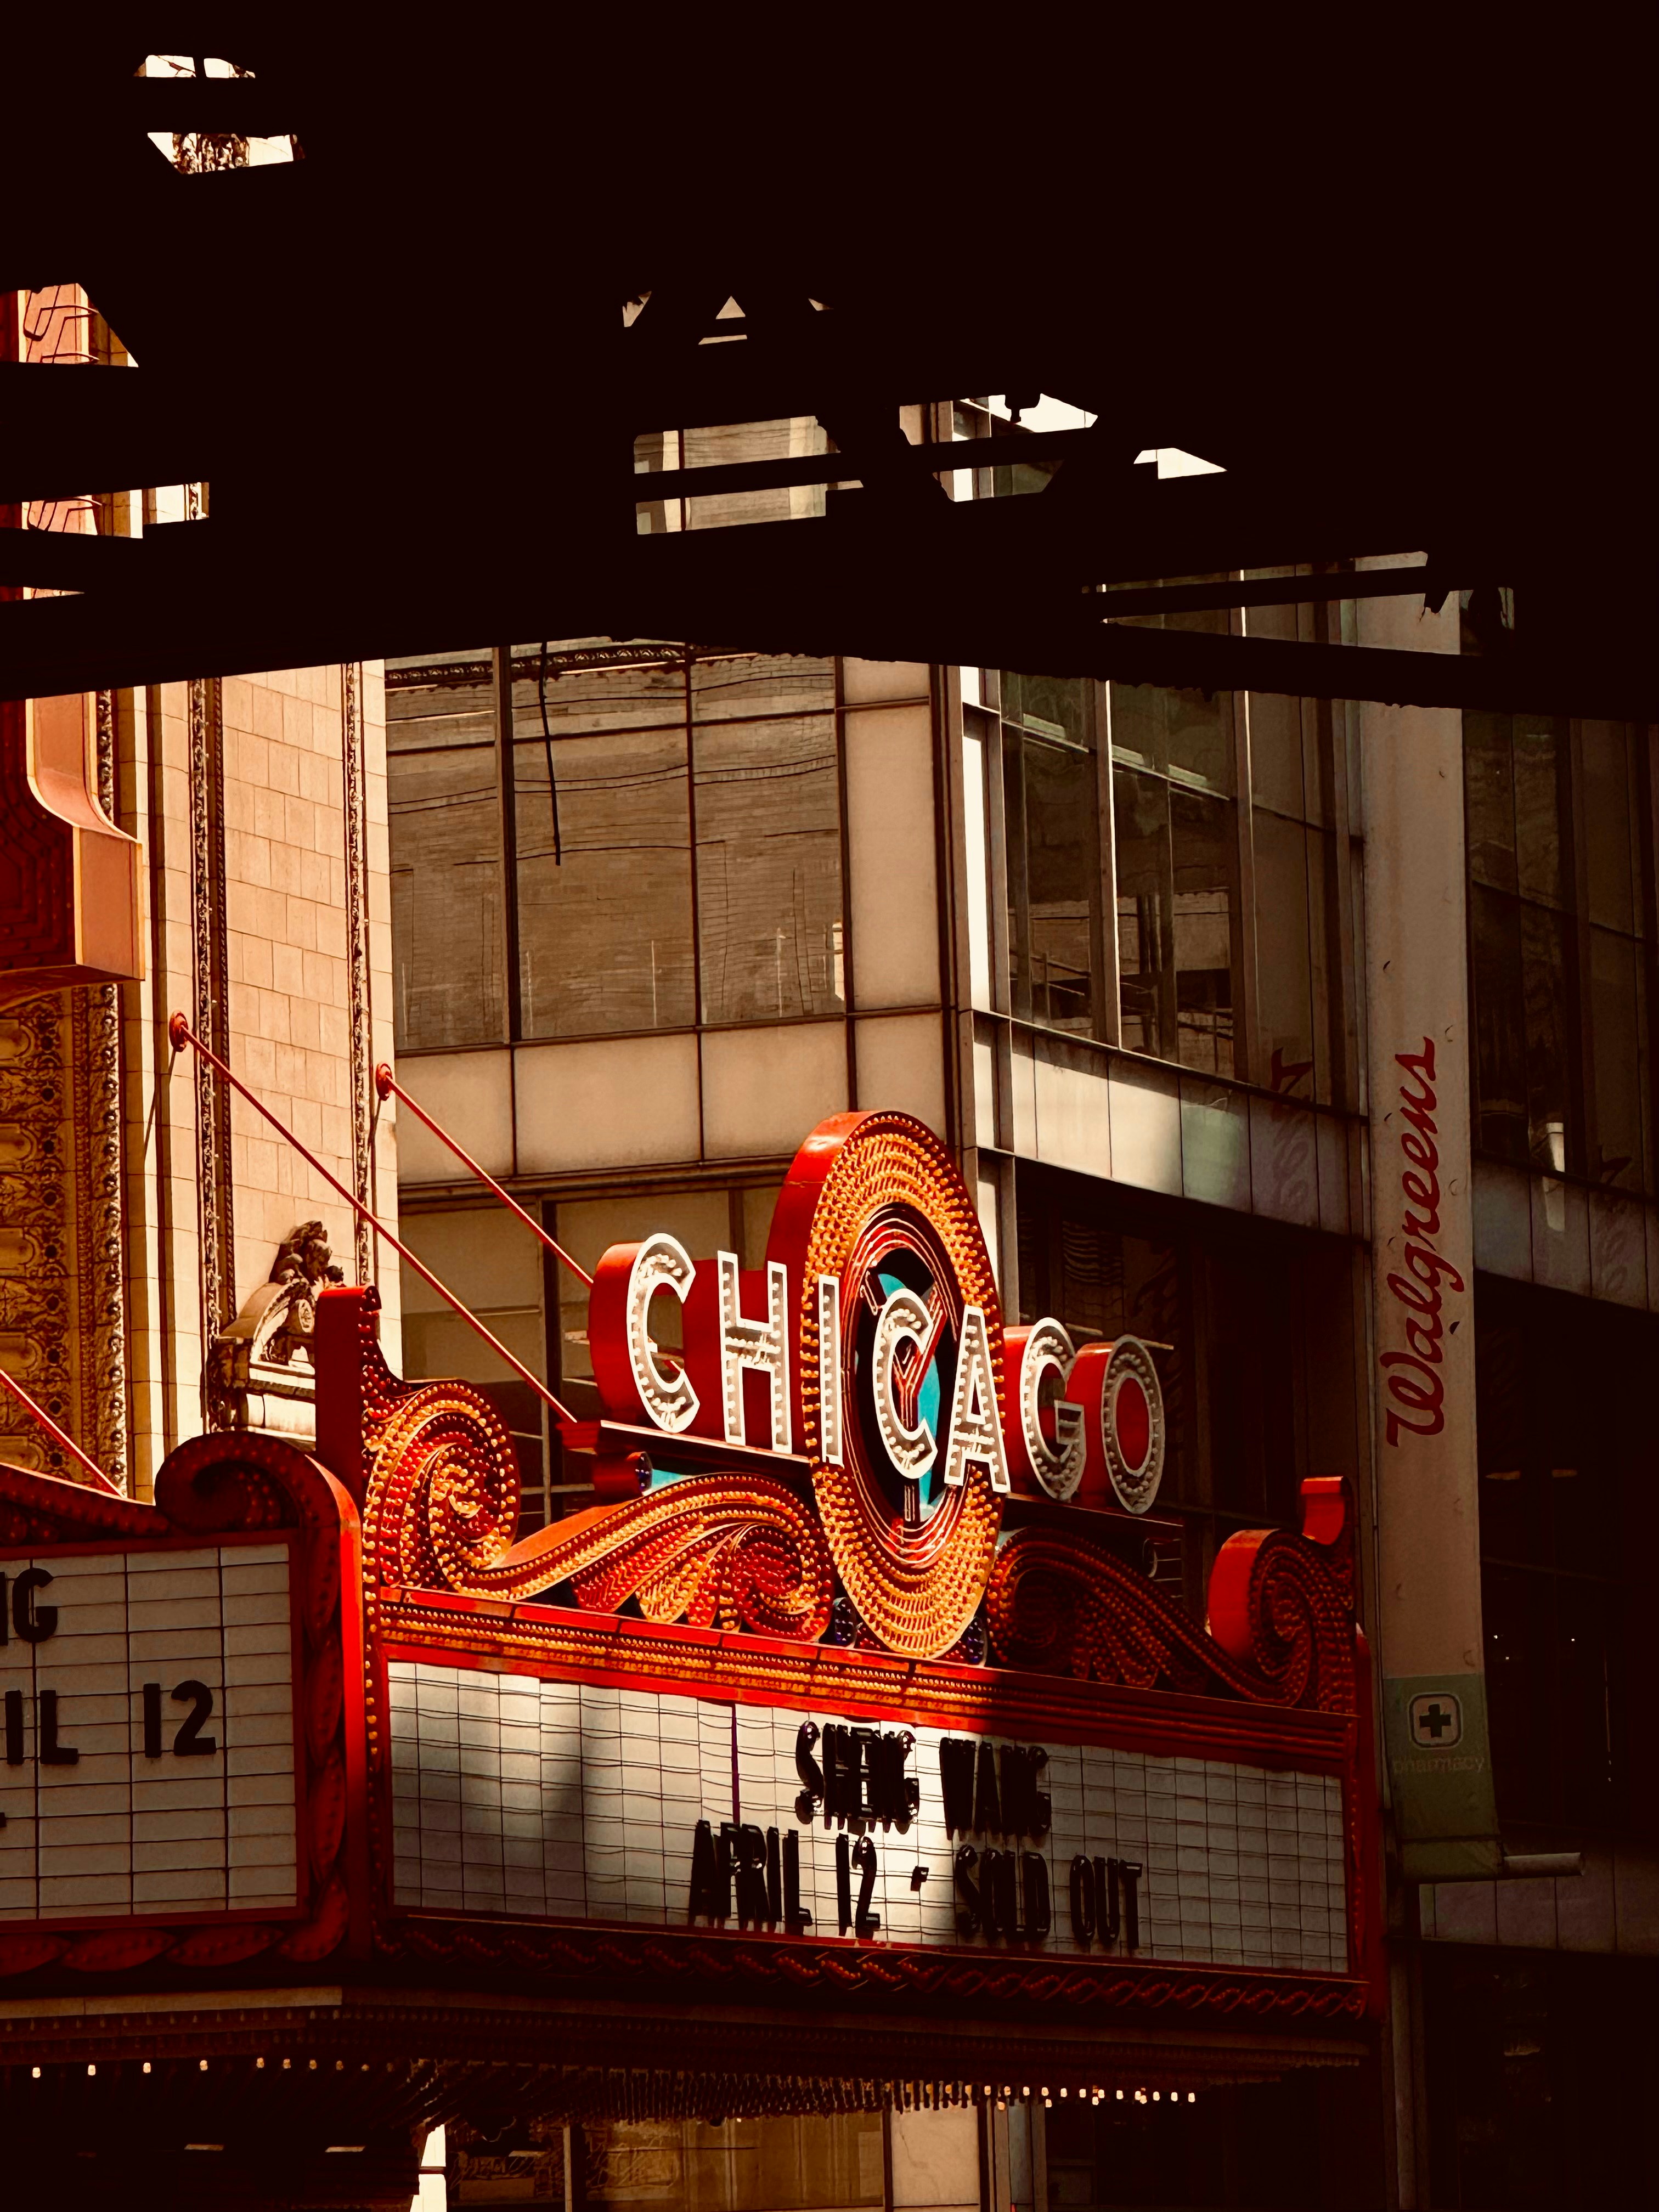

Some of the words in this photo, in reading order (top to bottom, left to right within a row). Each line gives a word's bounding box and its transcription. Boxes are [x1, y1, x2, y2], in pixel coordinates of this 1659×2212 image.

[1380, 1037, 1464, 1447] Walgreens
[624, 1233, 1165, 1514] CHICAGO
[0, 1568, 58, 1645] G
[143, 1680, 217, 1757] 12
[689, 1820, 812, 1935] APRIL
[836, 1833, 880, 1938] 12
[955, 1845, 1051, 1940] SOLD
[1070, 1855, 1143, 1949] OUT
